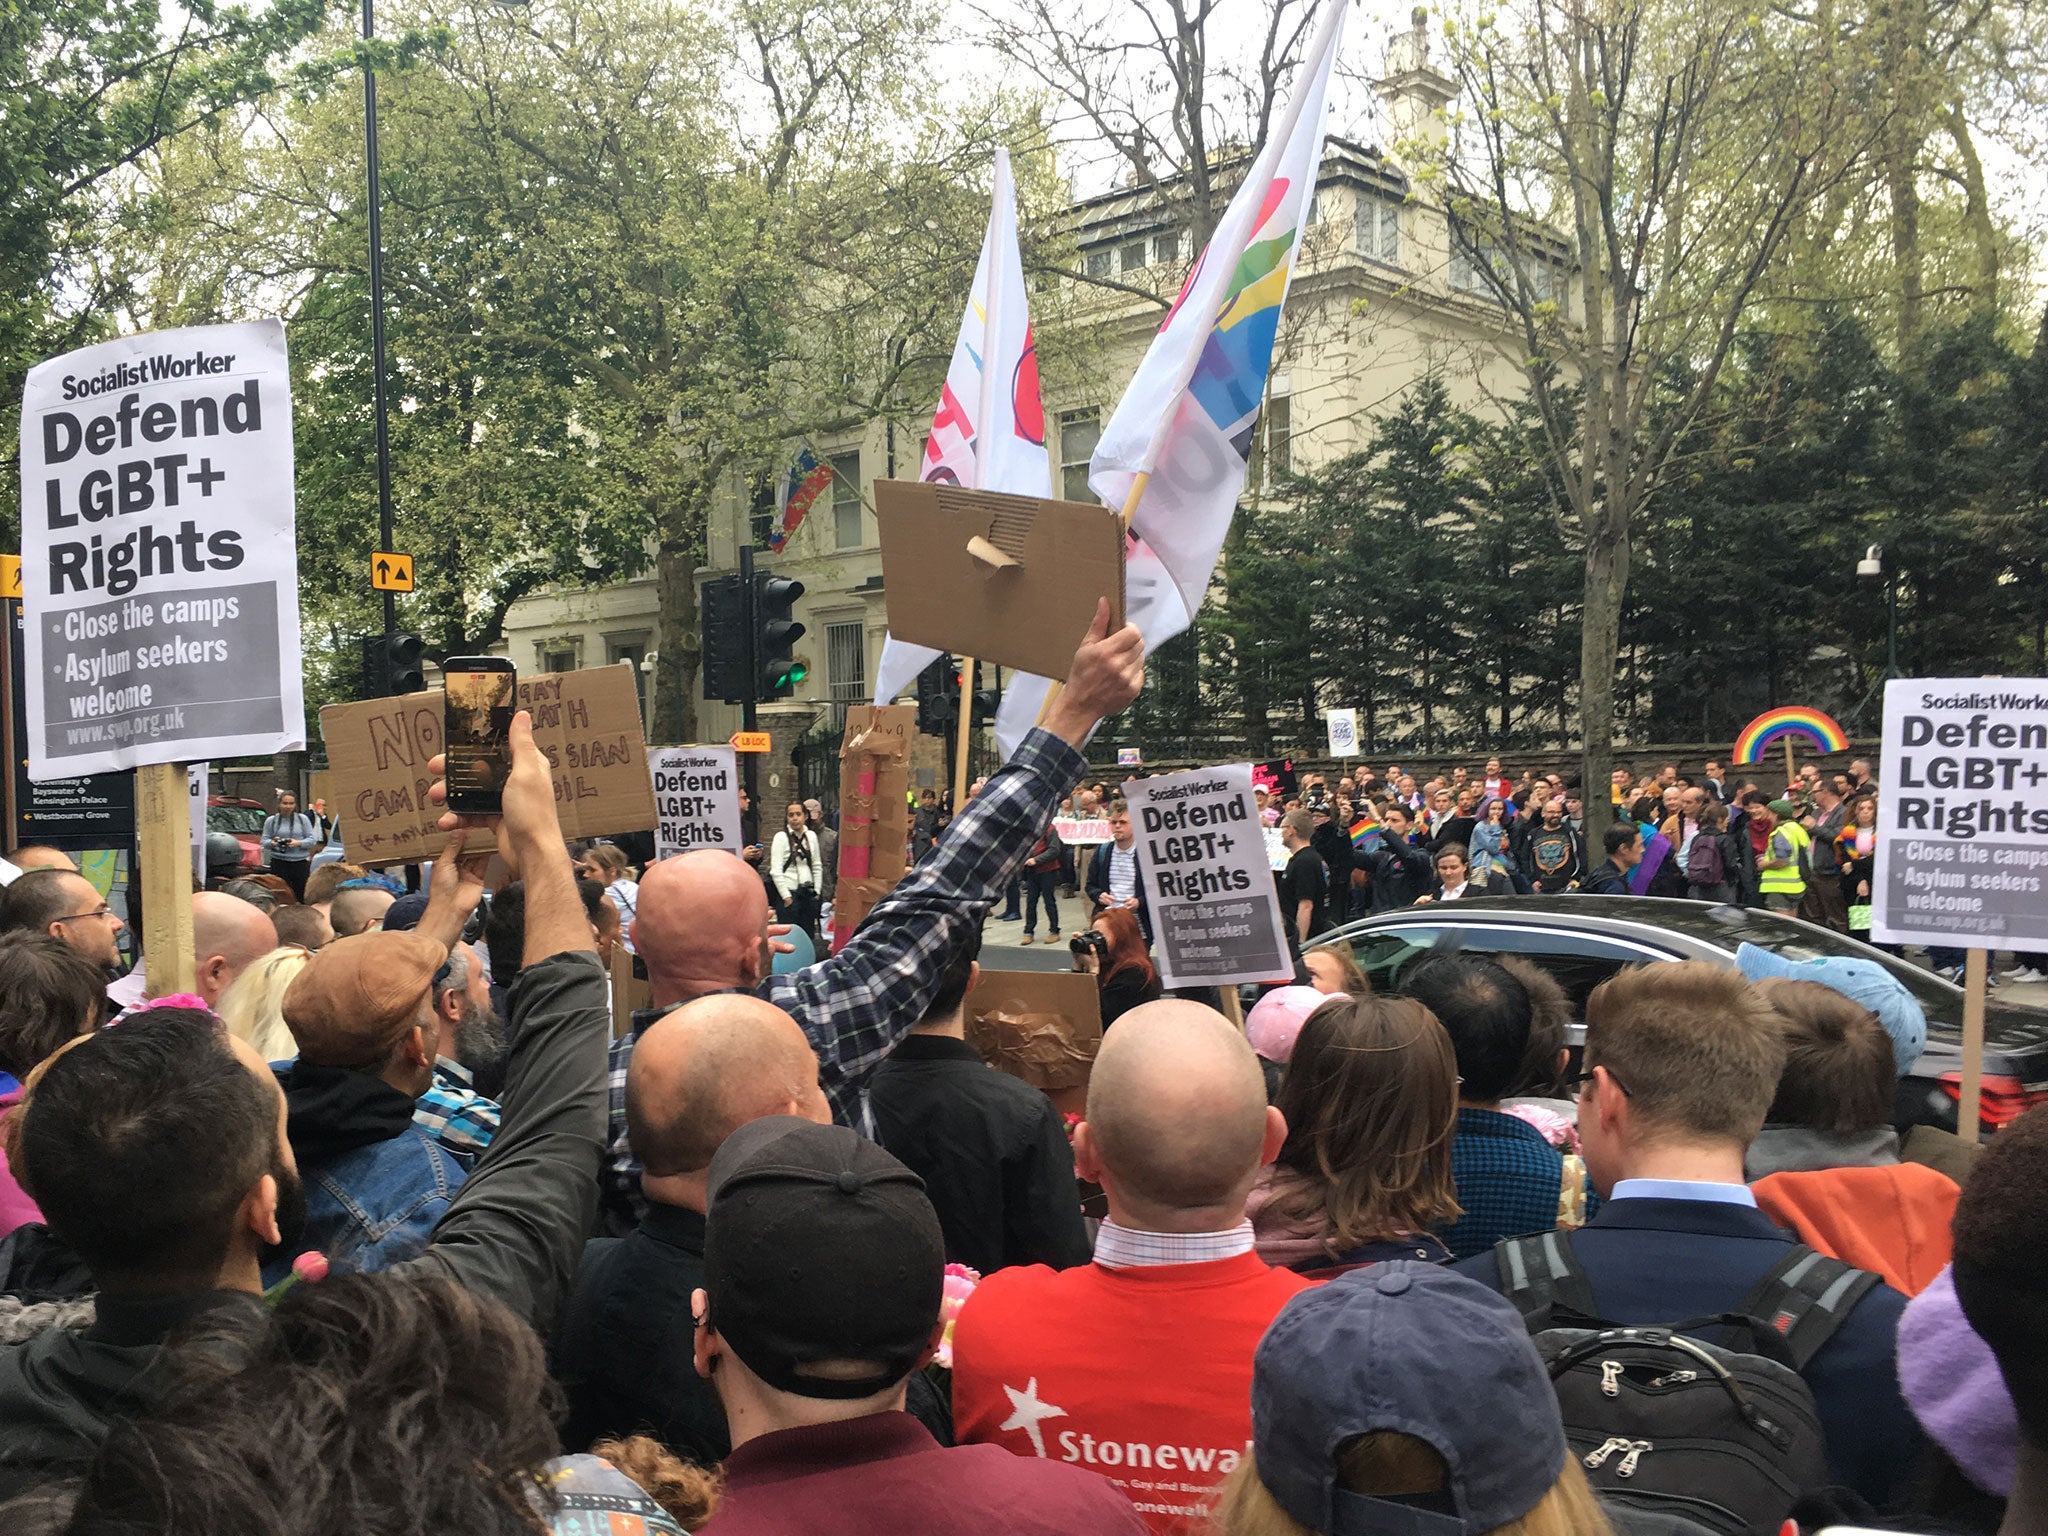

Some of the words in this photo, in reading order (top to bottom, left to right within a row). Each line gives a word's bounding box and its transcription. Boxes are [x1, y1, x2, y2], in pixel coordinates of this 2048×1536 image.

[42, 379, 262, 465] Defend
[46, 454, 225, 530] LGBT+
[49, 521, 245, 596] Rights
[64, 610, 118, 642] Close
[123, 601, 154, 630] the
[161, 596, 240, 632] camps
[64, 648, 131, 687] Asylum
[137, 637, 228, 668] seekers
[69, 682, 152, 718] welcome
[525, 699, 589, 731] EATH
[67, 708, 184, 746] www.swp.org.uk
[368, 708, 443, 771] NO
[655, 770, 727, 792] Defend
[1899, 756, 2048, 790] LGBT+
[33, 787, 75, 797] Bayswater
[33, 797, 79, 806] Kensington
[81, 796, 108, 806] Palace
[657, 797, 716, 817] LGBT+
[33, 811, 85, 821] Westbourne
[86, 811, 111, 820] Grove
[1142, 794, 1247, 833] Defend
[1897, 797, 2048, 839] Rights
[661, 822, 724, 847] Rights
[1149, 832, 1234, 866] LGBT+
[1906, 841, 1954, 862] Close
[1959, 844, 1989, 863] the
[1993, 848, 2048, 870] camps
[1156, 865, 1251, 900] Rights
[1904, 867, 1966, 891] Asylum
[1970, 871, 2041, 892] seekers
[1907, 892, 1982, 912] welcome
[1207, 922, 1251, 939] seekers
[1058, 1431, 1254, 1474] Stonewa
[1156, 1482, 1178, 1491] and
